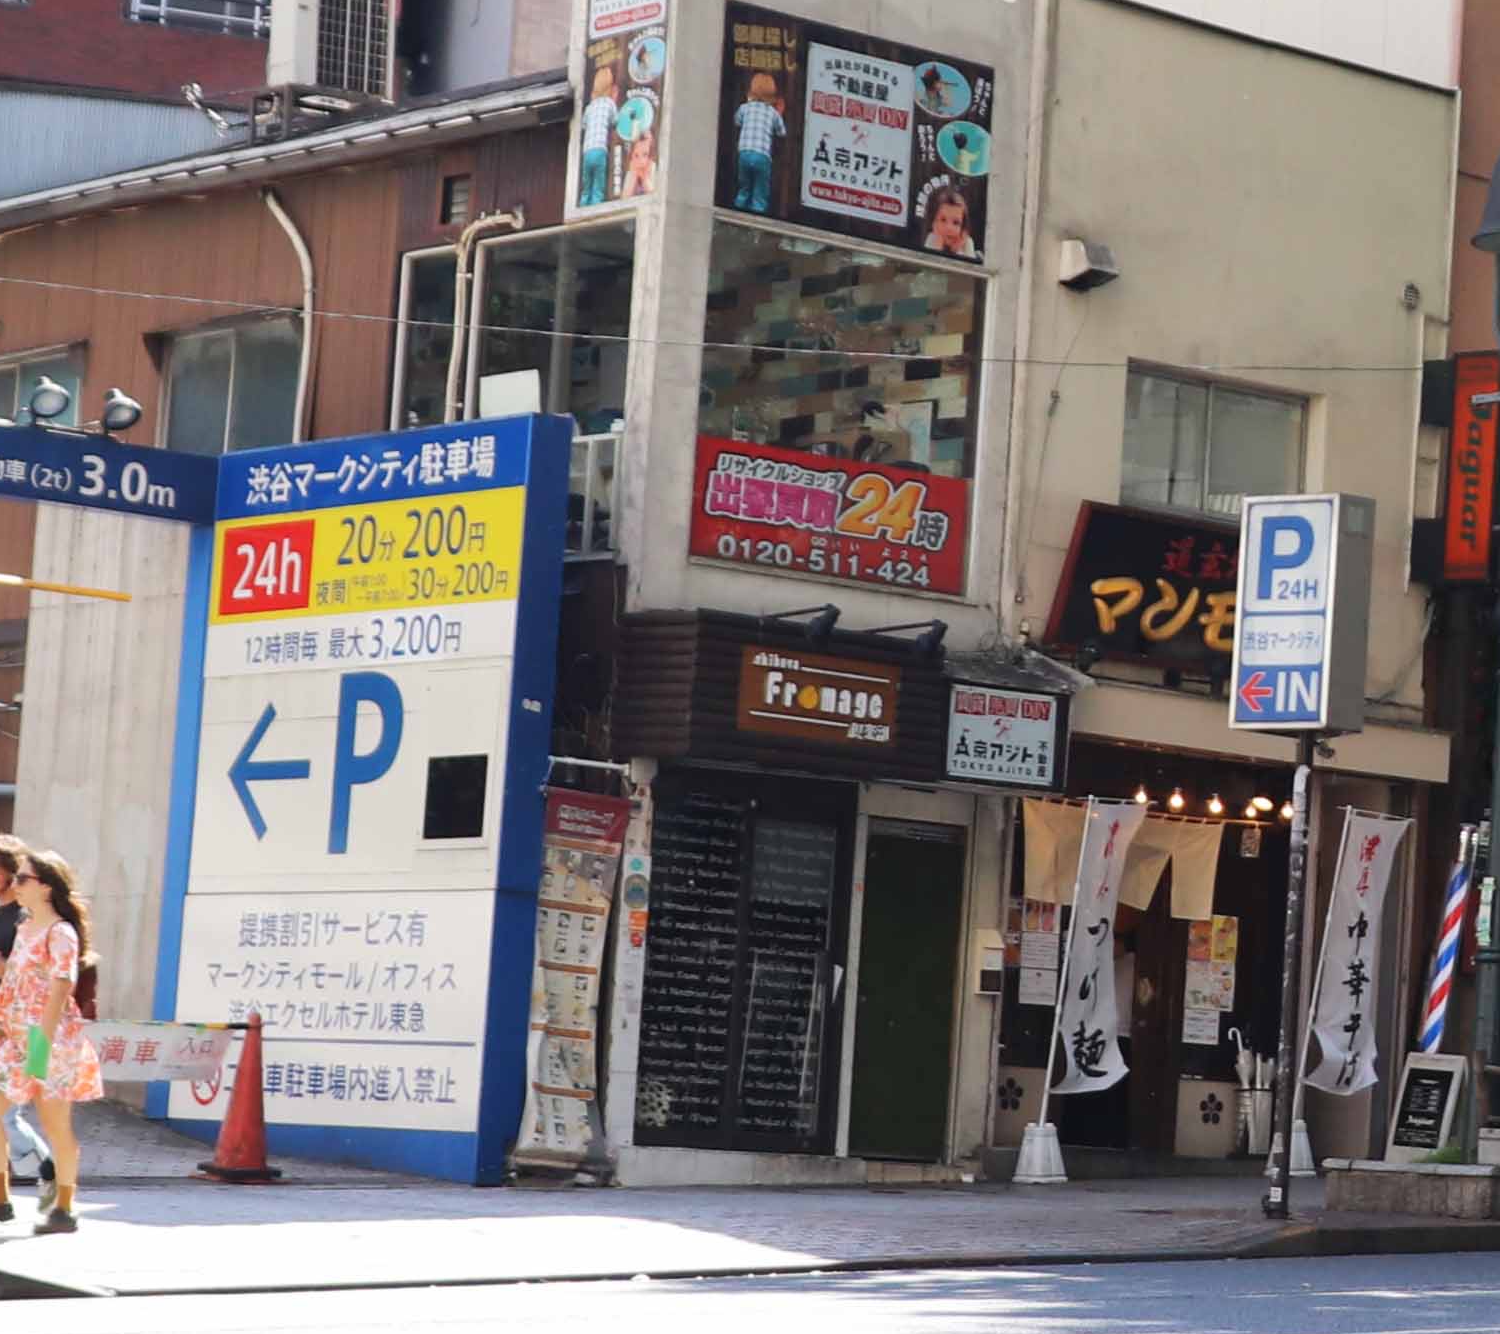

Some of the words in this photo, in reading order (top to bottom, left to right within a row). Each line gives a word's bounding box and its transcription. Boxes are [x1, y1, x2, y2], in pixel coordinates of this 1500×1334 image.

[811, 166, 858, 184] TOKYO
[78, 454, 176, 509] 3.0m
[246, 434, 496, 506] 渋谷マークシティ駐車場
[719, 454, 846, 490] リサイクルショップ
[231, 537, 301, 600] 24h
[337, 514, 397, 567] 20分
[403, 504, 486, 559] 200円
[717, 534, 930, 587] 0120-511-424
[1257, 515, 1315, 600] P
[407, 567, 449, 602] 30分
[451, 561, 509, 597] 200円
[1277, 578, 1319, 601] 24H
[245, 630, 318, 665] 12時間毎
[328, 626, 365, 660] 最大
[368, 613, 462, 662] 3,200円
[1275, 670, 1319, 713] IN
[327, 670, 405, 856] P
[238, 910, 429, 949] 提携割引サービス有
[228, 1000, 426, 1034] 渋谷エクセルホテル東急
[224, 1063, 456, 1104] 二車駐車場内進入禁止
